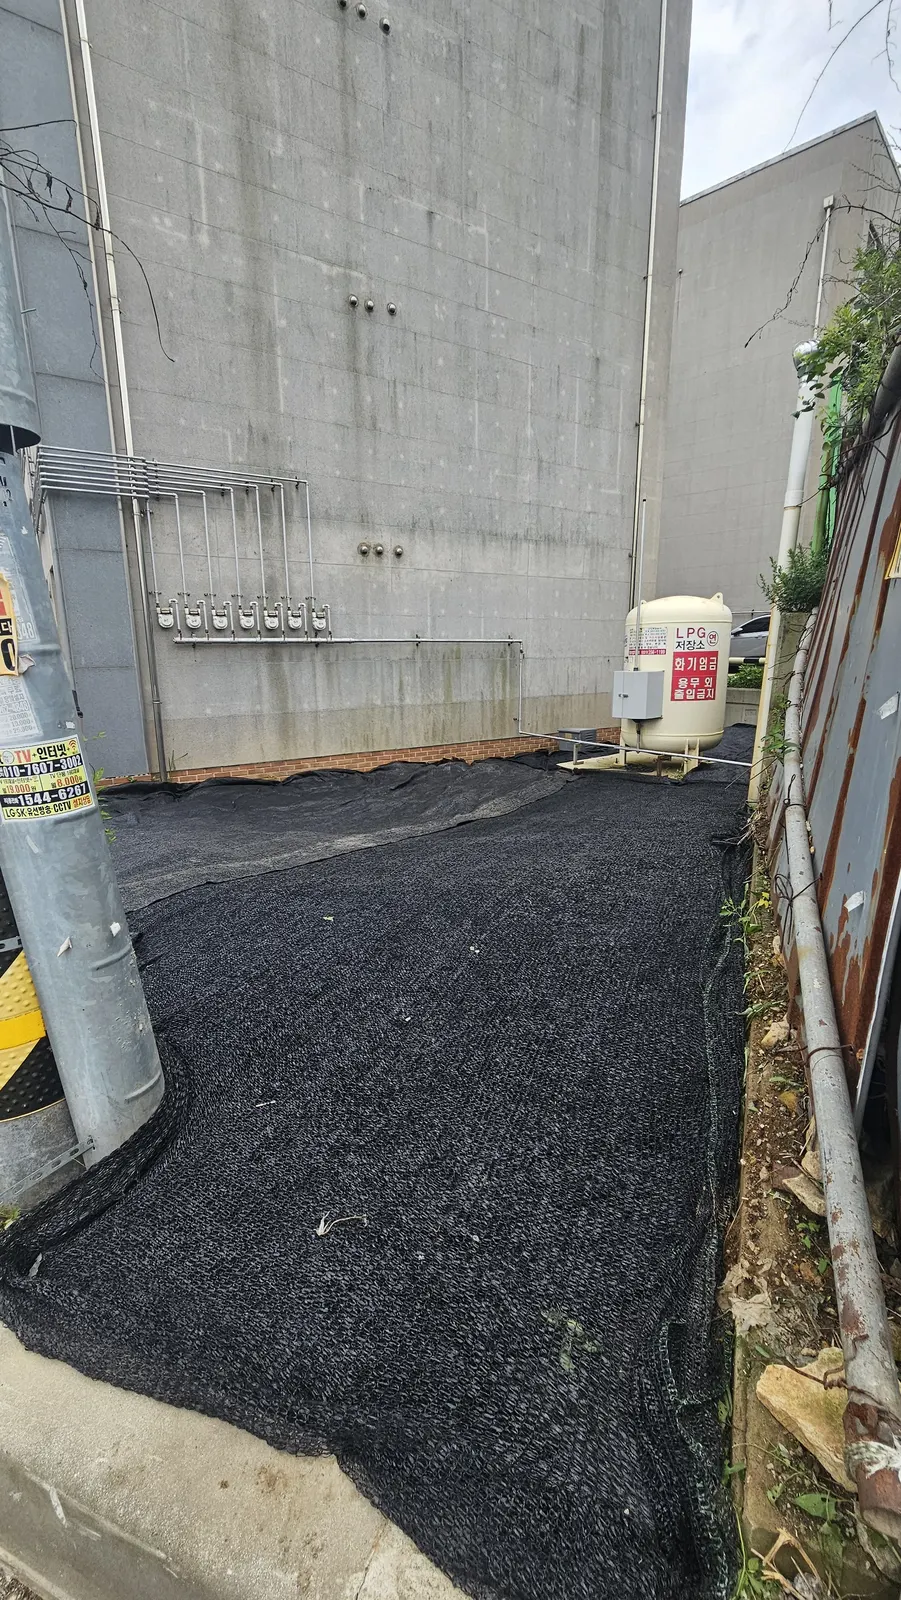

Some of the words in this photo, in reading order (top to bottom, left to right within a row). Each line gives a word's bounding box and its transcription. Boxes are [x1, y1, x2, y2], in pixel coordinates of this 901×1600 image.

[676, 627, 706, 639] LPG
[708, 633, 717, 645] 연
[675, 640, 706, 651] 저장소
[678, 677, 700, 688] 용무
[704, 677, 713, 688] 외
[674, 688, 714, 700] 출입금지
[14, 749, 32, 763] TV
[37, 743, 67, 760] 인터넷
[18, 783, 87, 806] 1544-6267
